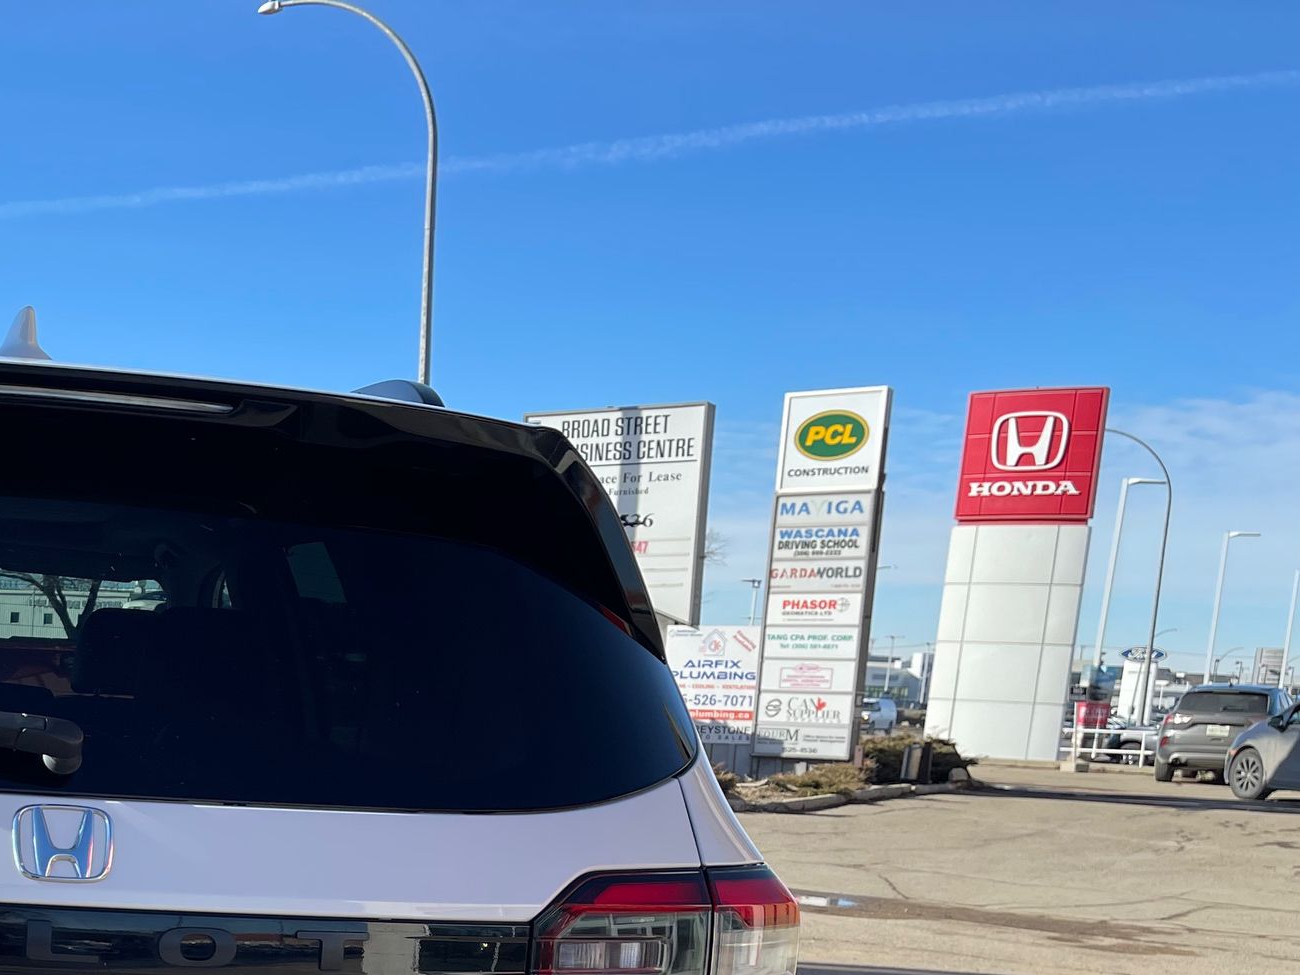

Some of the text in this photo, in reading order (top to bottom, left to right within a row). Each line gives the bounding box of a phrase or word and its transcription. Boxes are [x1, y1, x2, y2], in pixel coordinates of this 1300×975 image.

[562, 414, 671, 439] BROAD STREET
[805, 424, 857, 446] PCL
[575, 437, 695, 462] SINESS CENTRE
[787, 466, 869, 477] CONSTRUCTION
[599, 472, 682, 484] ace For Lease
[968, 480, 1081, 497] HONDA
[779, 528, 860, 539] WASCANA
[778, 539, 860, 550] DRIVING SCHOOL
[782, 599, 838, 609] PHASOR
[684, 660, 741, 669] AIRFIX
[672, 671, 756, 680] PLUMBING
[683, 694, 753, 707] 6-526-7071
[690, 710, 750, 719] plumbing.ca
[696, 725, 751, 735] REYSTONE
